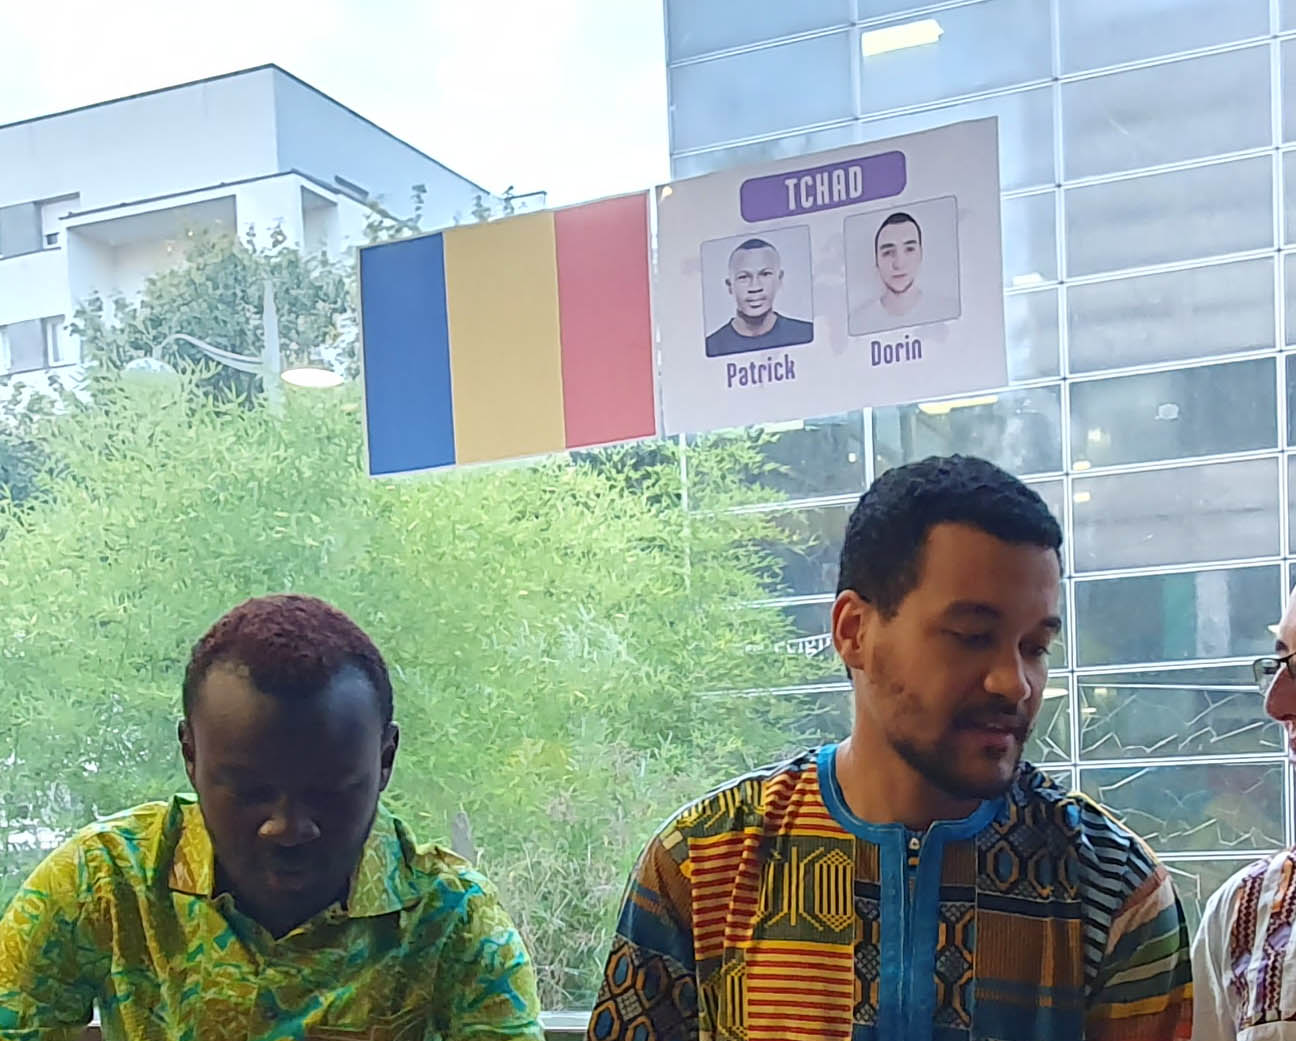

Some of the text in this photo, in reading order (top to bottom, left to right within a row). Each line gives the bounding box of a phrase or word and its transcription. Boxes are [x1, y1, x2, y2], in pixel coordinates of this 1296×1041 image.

[785, 165, 863, 211] TCHAD
[870, 334, 922, 367] Dorin
[726, 354, 796, 388] Patrick
